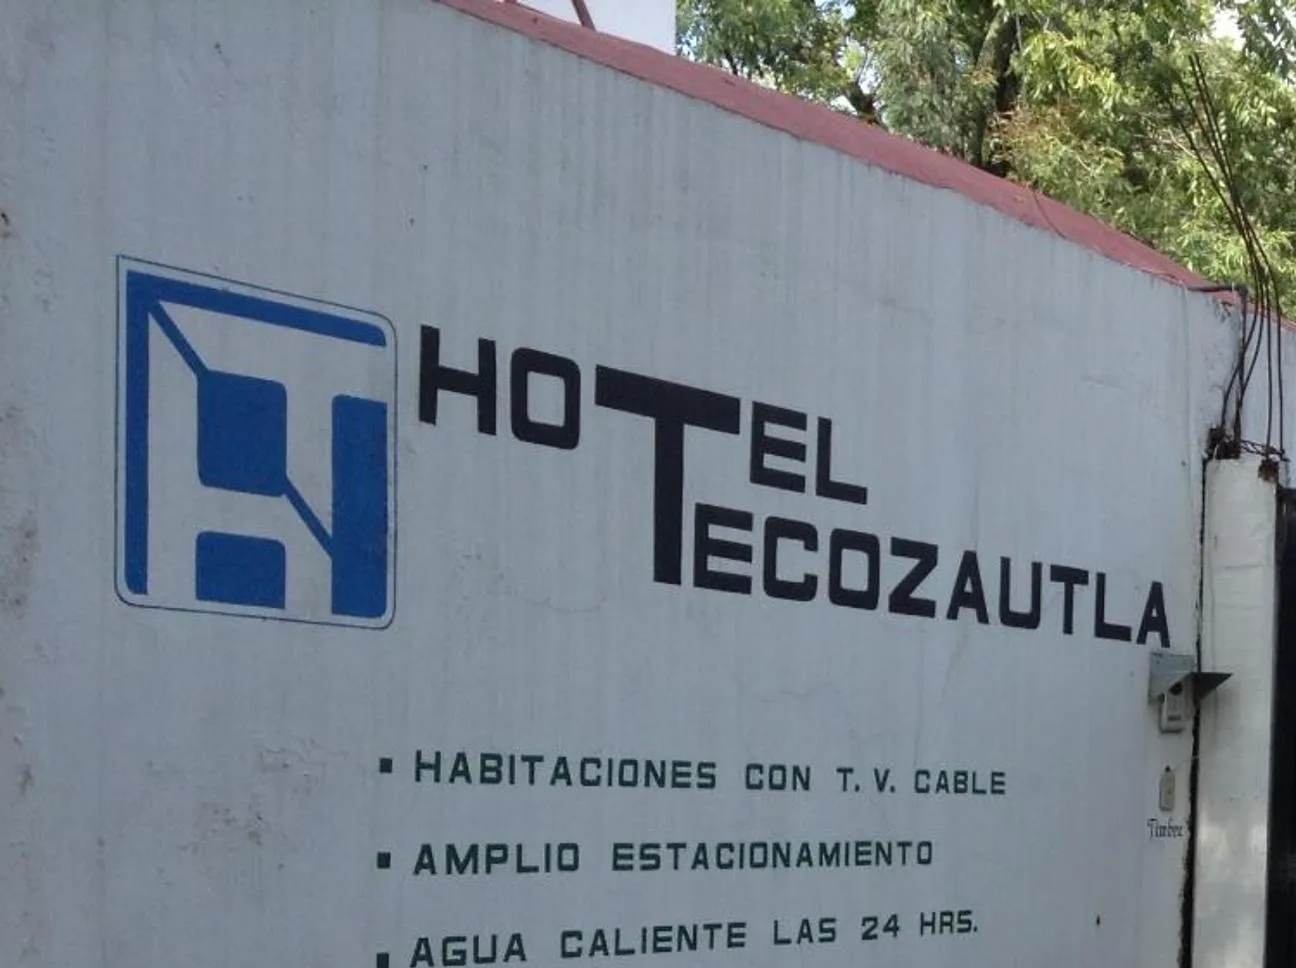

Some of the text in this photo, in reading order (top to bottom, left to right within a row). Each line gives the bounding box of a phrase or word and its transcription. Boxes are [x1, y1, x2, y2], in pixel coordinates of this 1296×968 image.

[418, 324, 868, 586] HOTEL
[414, 750, 717, 790] HABITACIONES
[744, 763, 811, 791] CON
[913, 769, 1007, 796] CABLE
[413, 841, 933, 876] AMPLIO ESTACIONAMIENTO
[408, 909, 979, 968] AGUA CALIENTE LAS 24 HRS.
